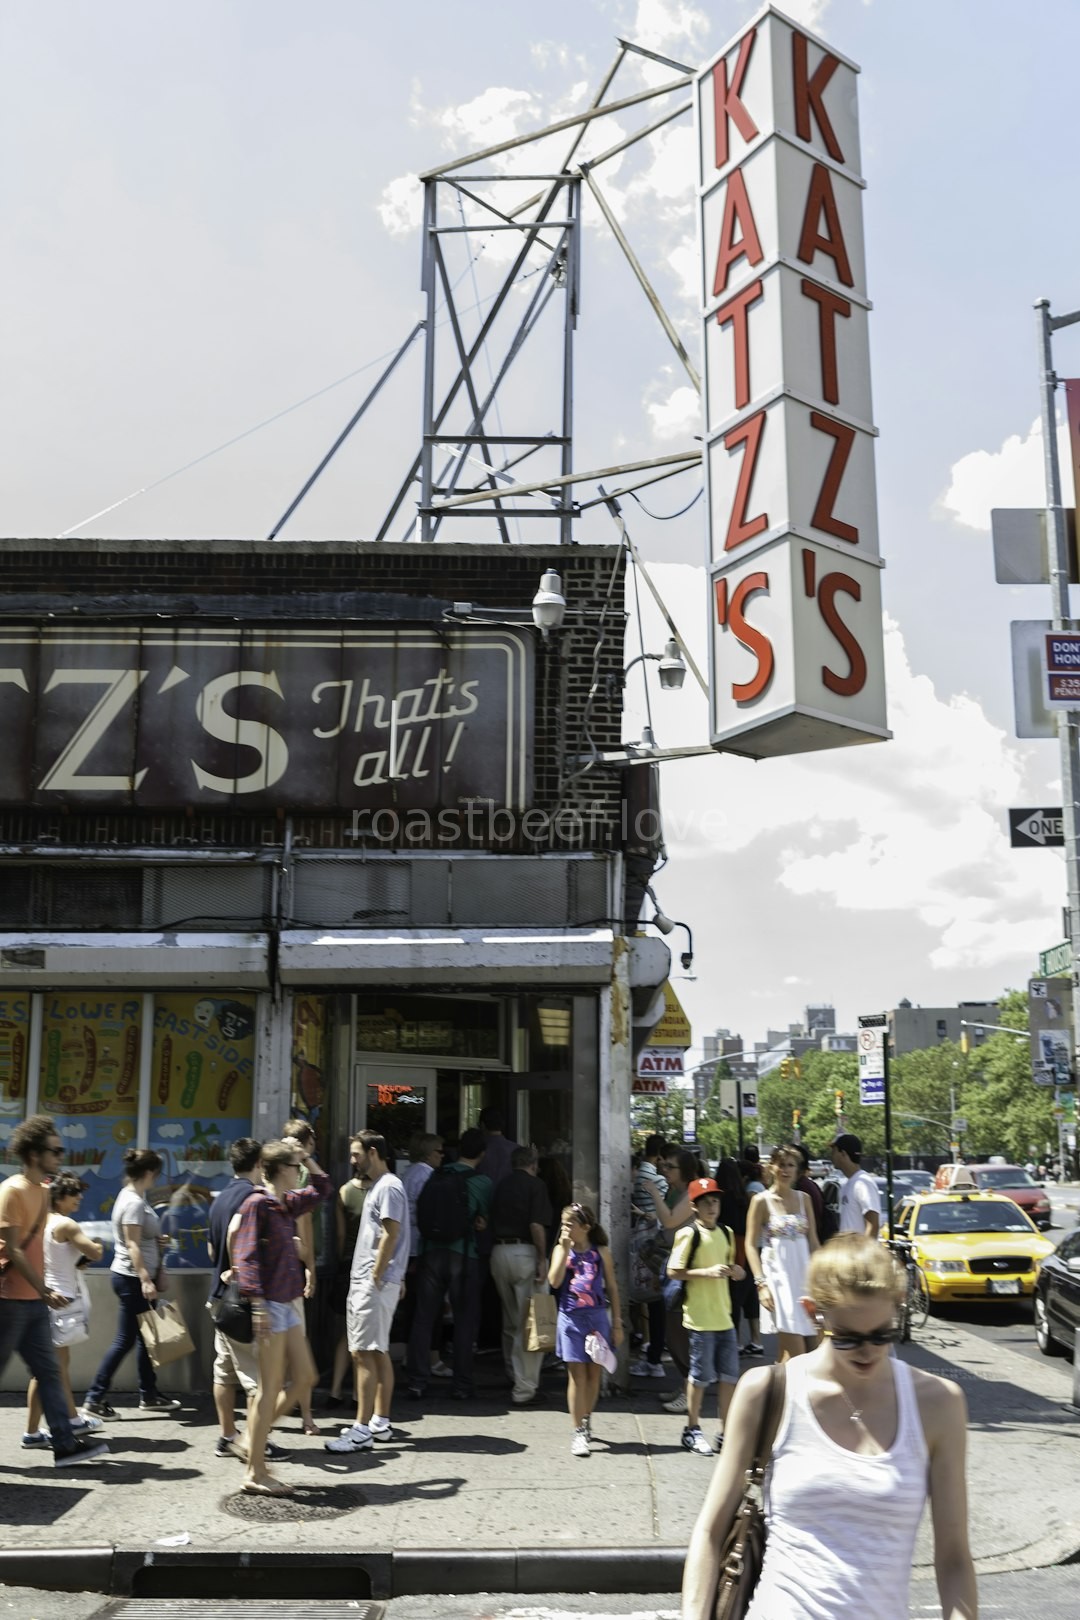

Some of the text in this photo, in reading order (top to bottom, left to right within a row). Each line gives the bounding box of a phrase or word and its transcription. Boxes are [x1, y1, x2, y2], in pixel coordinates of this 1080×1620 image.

[712, 28, 774, 702] KATZ'S
[792, 31, 867, 697] KATZ'S
[312, 668, 480, 739] That's
[1029, 819, 1064, 836] ONE
[50, 1000, 140, 1021] LOWER
[154, 1006, 208, 1041] EAST
[640, 1057, 683, 1071] ATM
[632, 1080, 666, 1092] ATM
